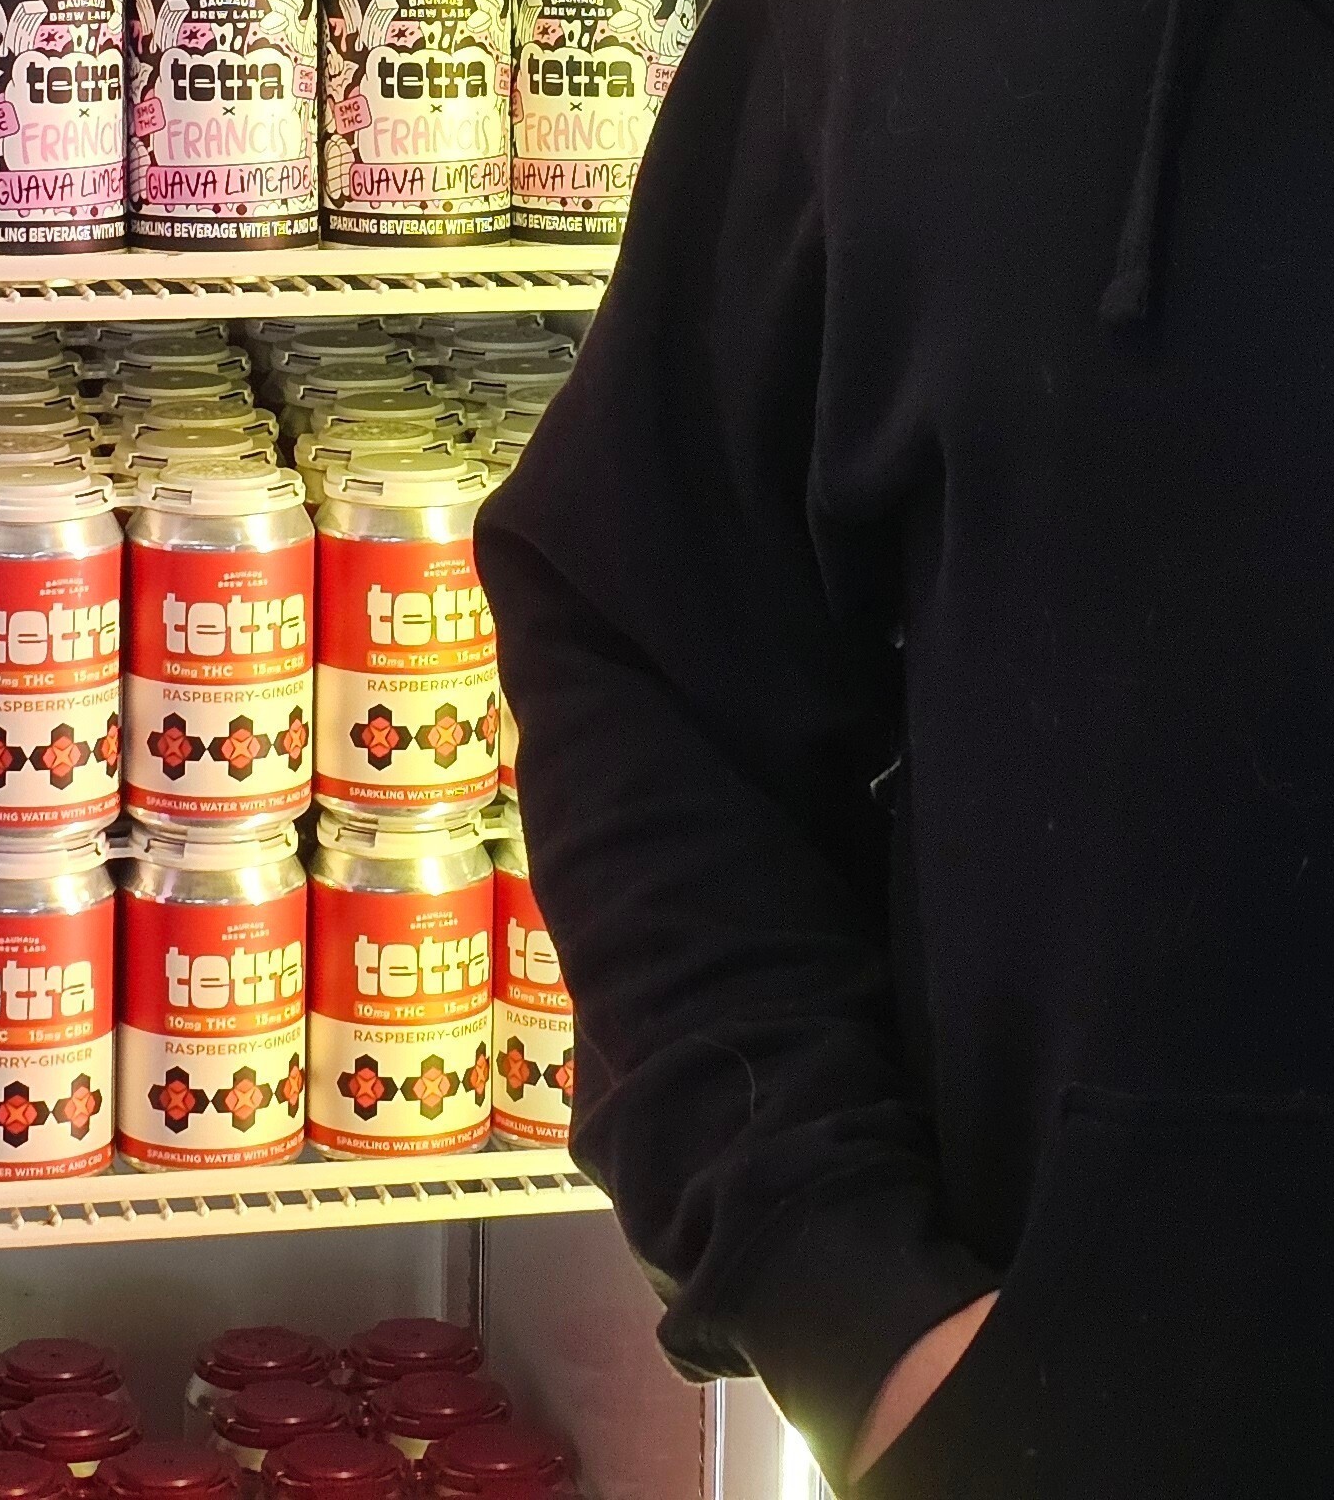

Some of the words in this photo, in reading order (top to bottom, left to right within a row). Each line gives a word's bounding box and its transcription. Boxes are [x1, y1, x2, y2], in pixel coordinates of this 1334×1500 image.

[26, 60, 122, 104] tetra
[170, 58, 283, 100] tetra
[378, 56, 488, 99] tetra
[528, 54, 634, 98] tetra
[148, 172, 217, 200] GUAVA
[352, 165, 425, 197] GUAVA
[163, 593, 306, 657] tetra
[162, 681, 304, 704] RASPBERRY-GINGER
[166, 940, 302, 1009] tetra
[354, 931, 490, 998] tetra
[165, 1030, 302, 1055] RASPBERRY-GINGER
[168, 1016, 201, 1031] 10mg
[205, 1015, 237, 1029] THC
[354, 1016, 488, 1043] RASPBERRY-GINGER
